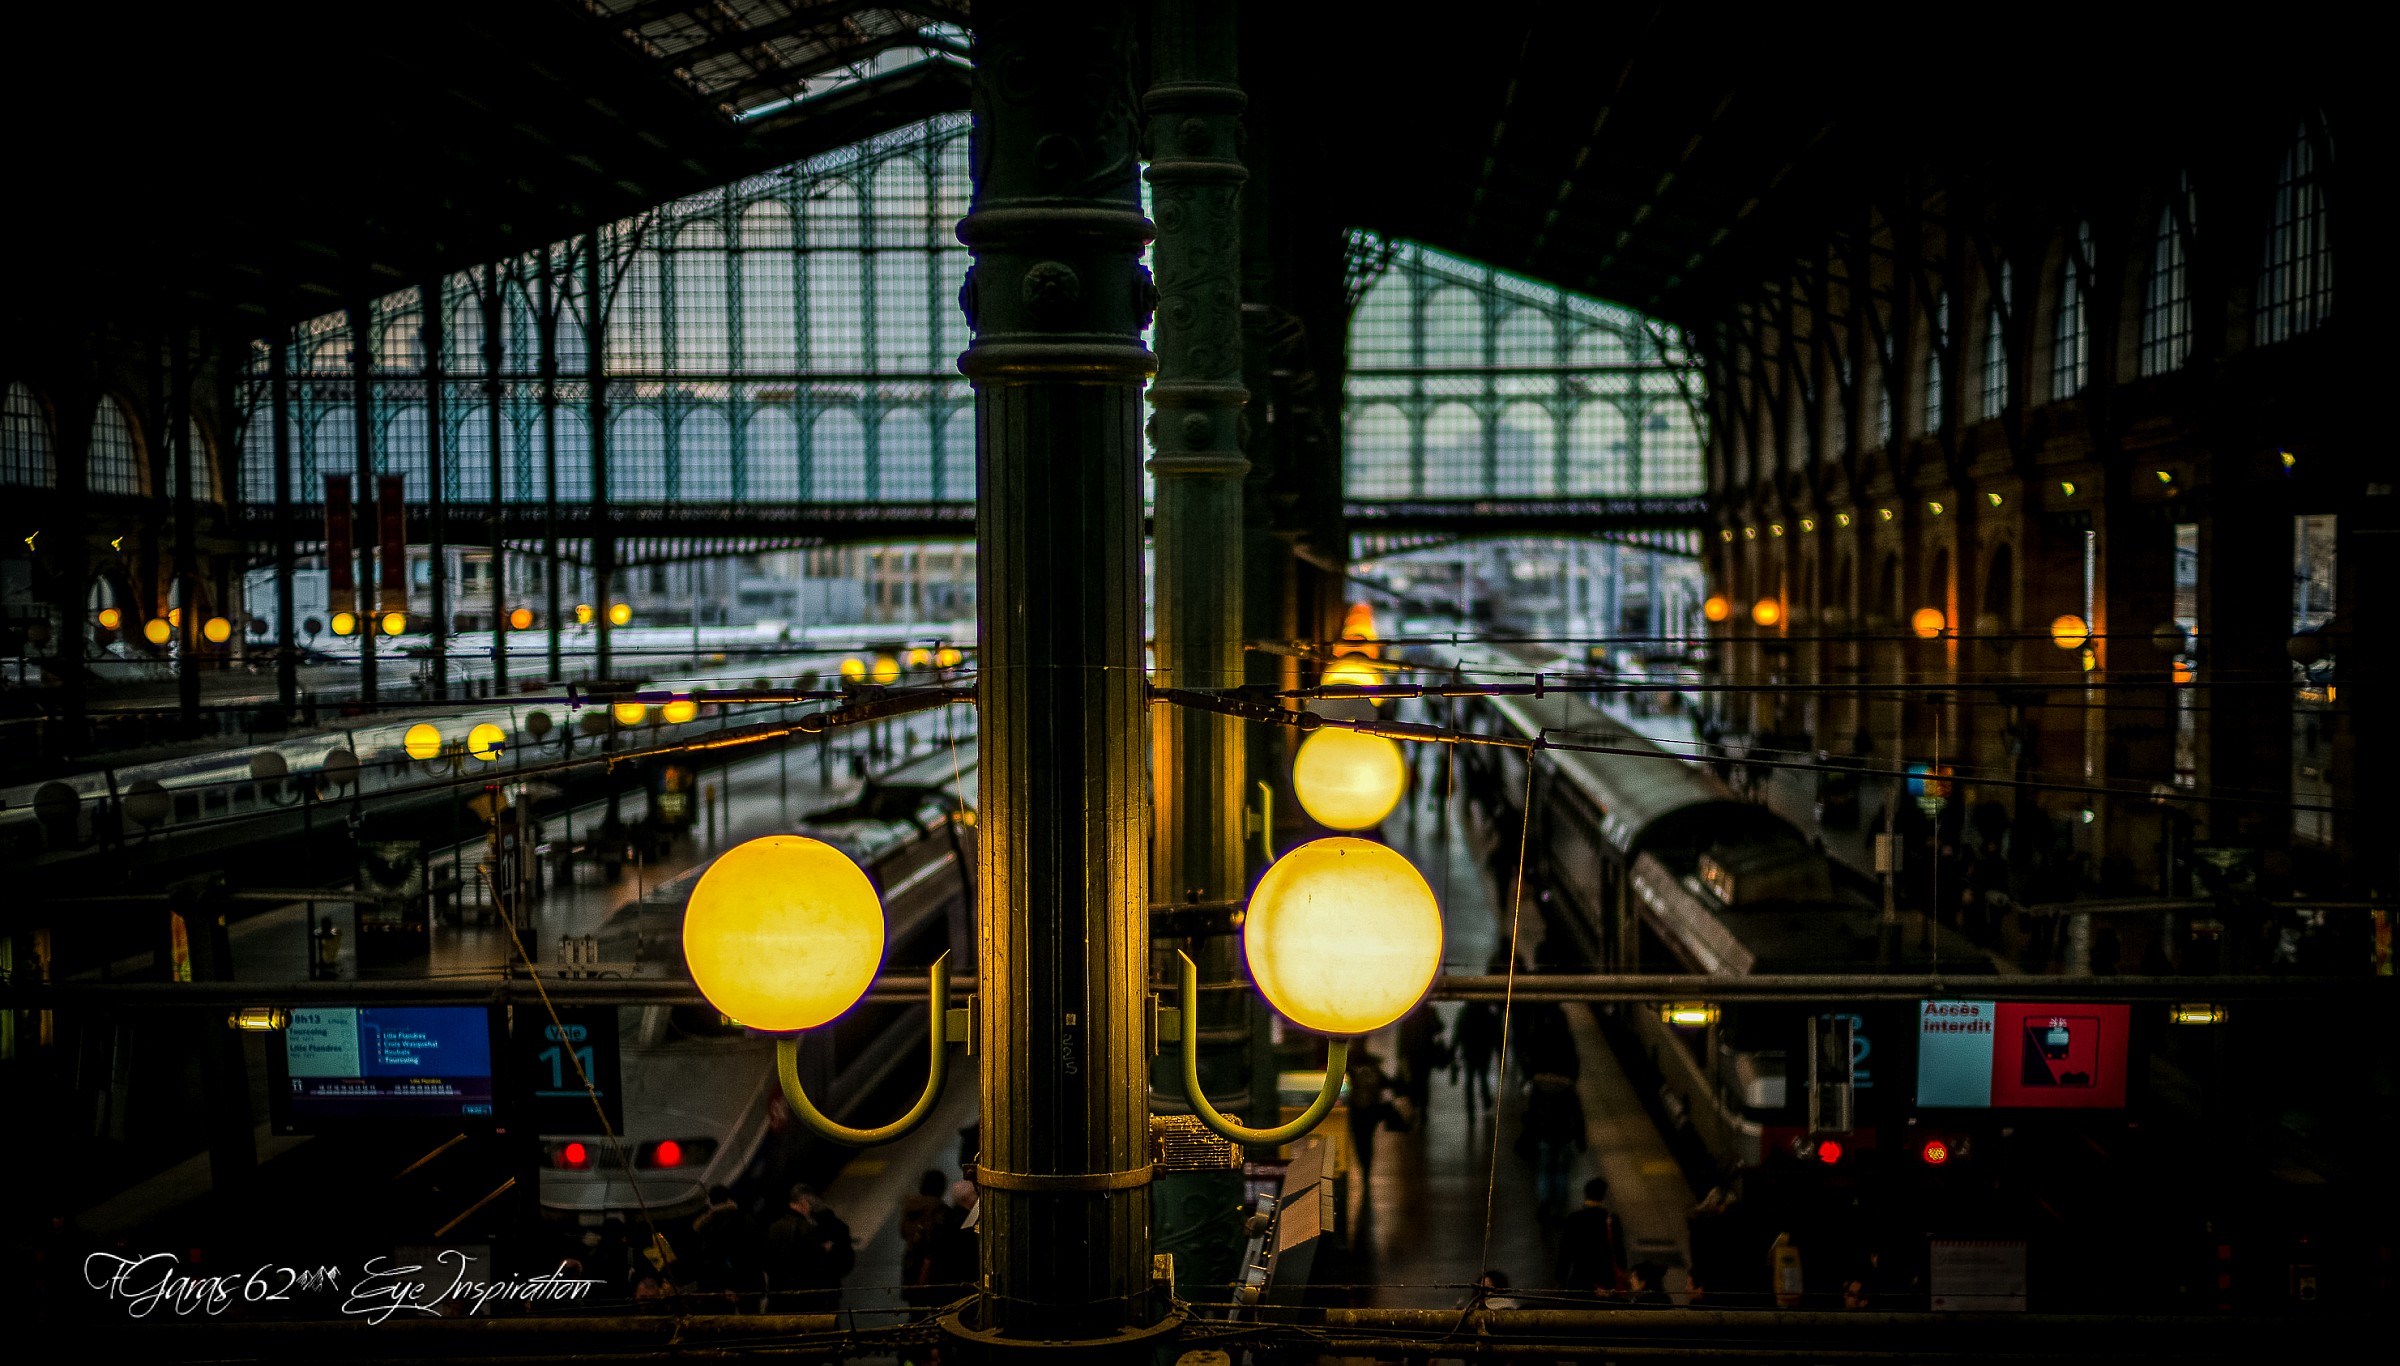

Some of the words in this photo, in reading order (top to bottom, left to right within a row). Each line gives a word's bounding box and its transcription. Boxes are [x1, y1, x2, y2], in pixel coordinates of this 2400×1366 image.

[1924, 1001, 1980, 1015] Accès
[1924, 1020, 1991, 1033] interdit
[537, 1045, 594, 1088] 11
